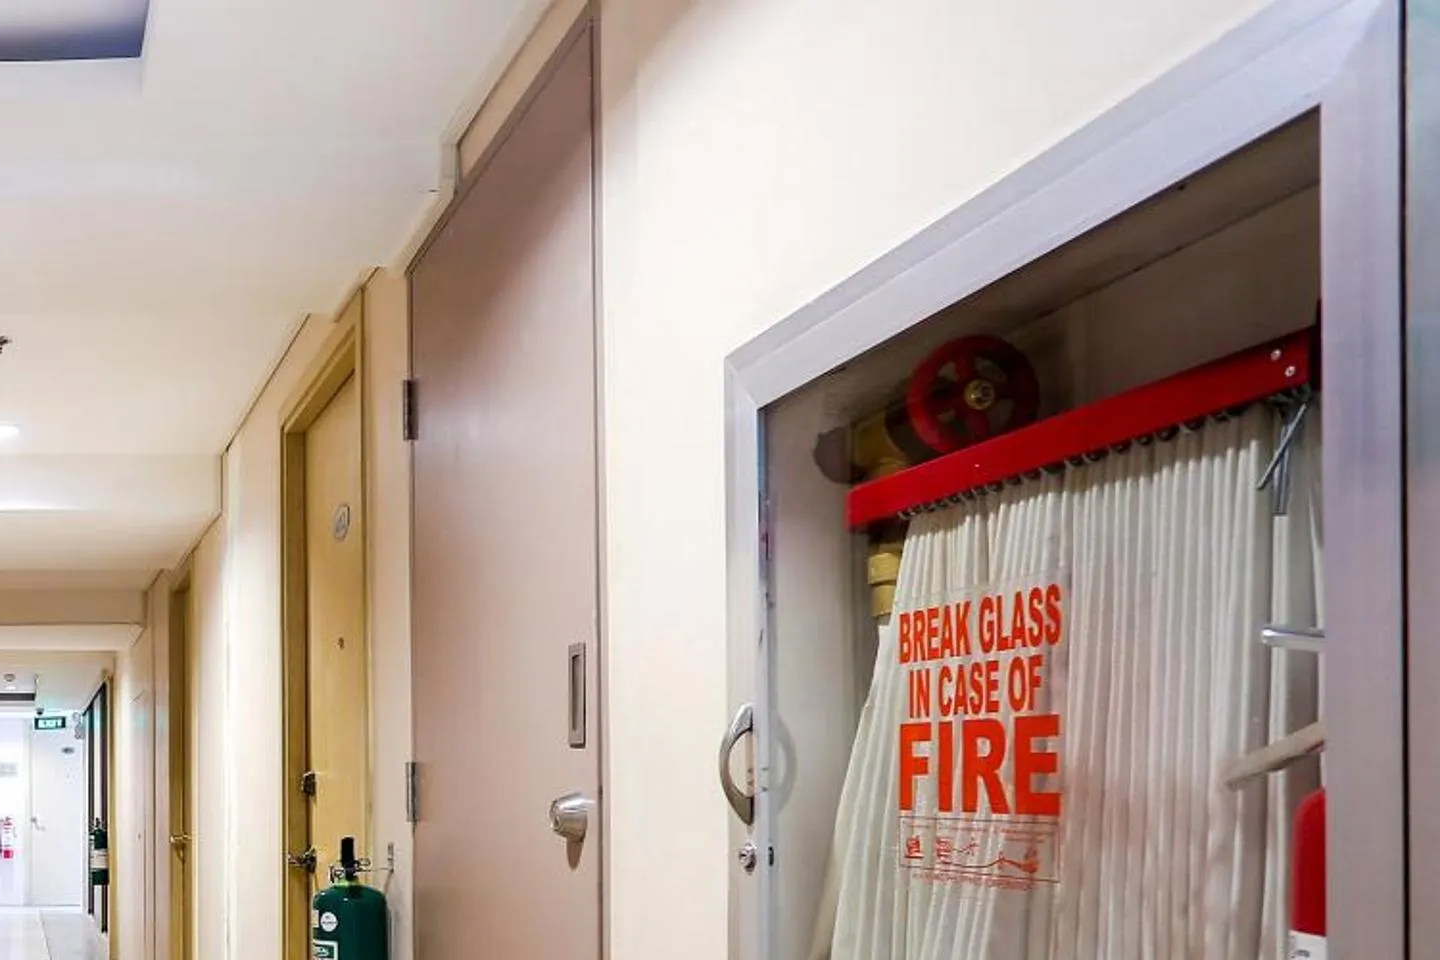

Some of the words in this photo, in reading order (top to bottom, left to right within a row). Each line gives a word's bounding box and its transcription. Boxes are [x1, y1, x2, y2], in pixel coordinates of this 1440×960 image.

[898, 601, 971, 665] BREAK
[978, 584, 1062, 654] GLASS
[908, 670, 931, 717] IN
[937, 659, 1001, 717] CASE
[1007, 654, 1044, 713] OF
[38, 719, 62, 728] EXIT
[899, 714, 1063, 818] FIRE
